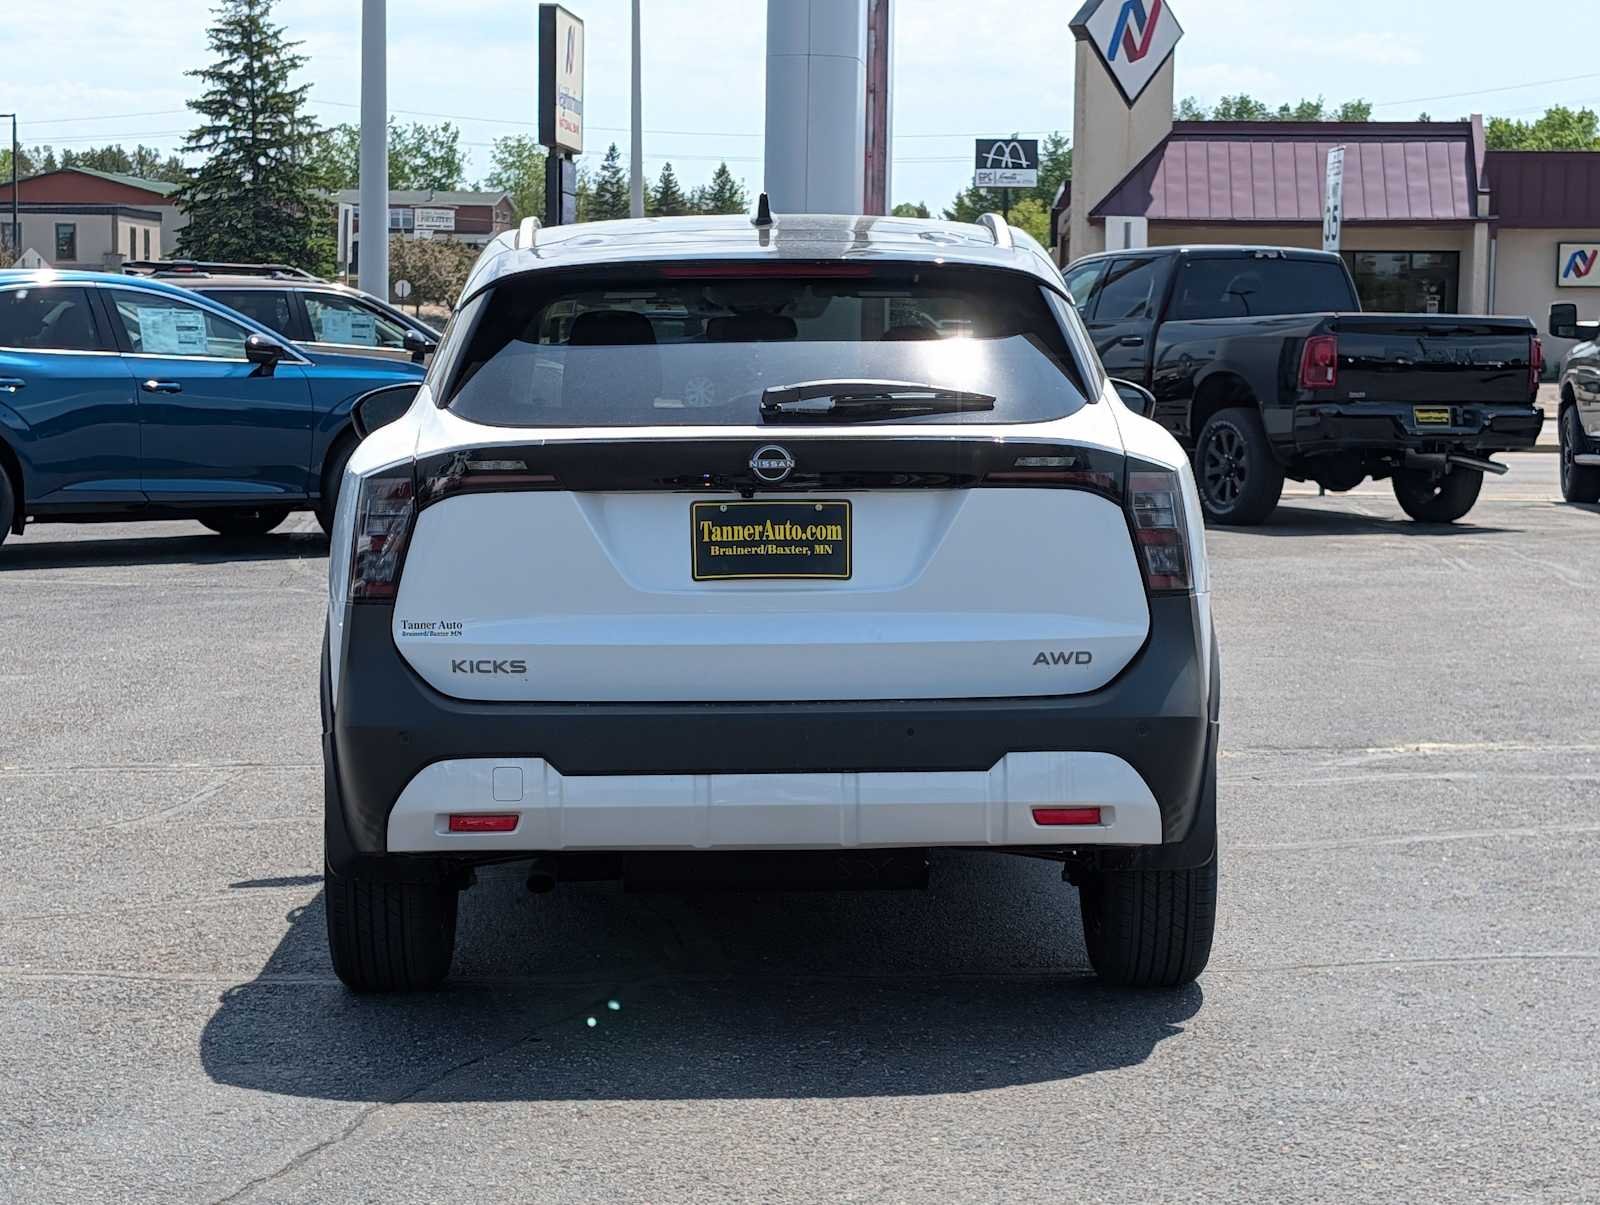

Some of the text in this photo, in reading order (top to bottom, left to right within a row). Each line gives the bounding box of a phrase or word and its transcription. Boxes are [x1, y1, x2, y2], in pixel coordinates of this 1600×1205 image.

[749, 459, 795, 468] NISSAN
[700, 519, 843, 542] TannerAuto.com
[710, 544, 833, 556] Brainerd/Baxter, MN
[400, 619, 463, 630] Tanner Auto
[1032, 651, 1093, 665] AWD
[451, 659, 527, 674] KICKS
